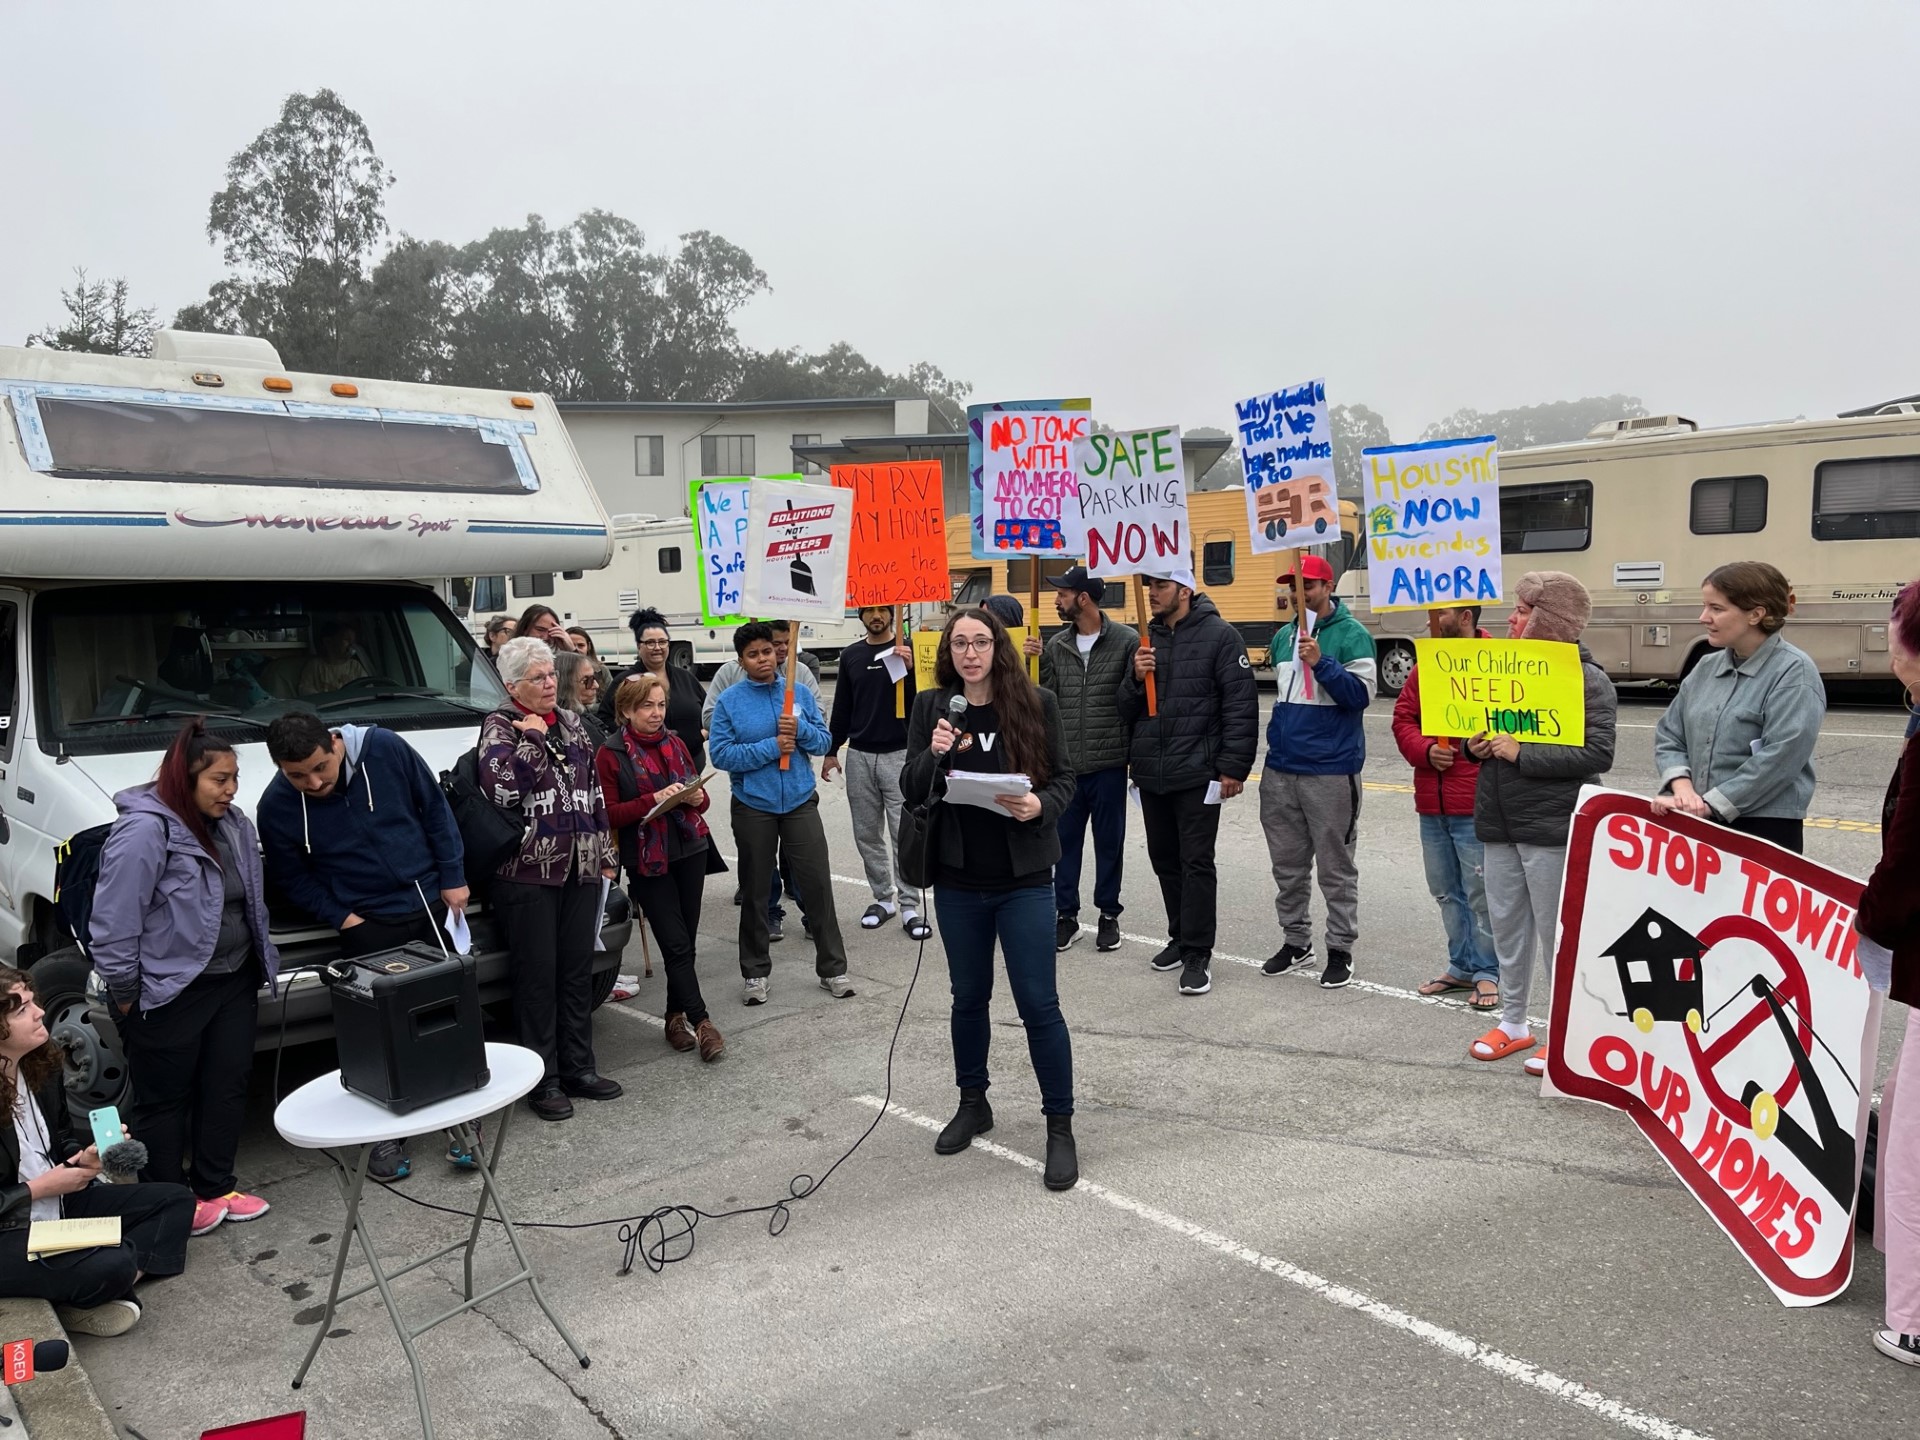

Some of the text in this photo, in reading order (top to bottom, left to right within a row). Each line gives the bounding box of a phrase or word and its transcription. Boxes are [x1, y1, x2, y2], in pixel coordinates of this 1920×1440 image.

[1235, 397, 1272, 427] Why
[1284, 410, 1316, 435] We
[991, 416, 1027, 452] NO
[1012, 445, 1068, 471] WITH
[1084, 429, 1176, 480] SAFE
[1242, 436, 1332, 475] have nowhere
[838, 467, 932, 504] MY RV
[996, 470, 1078, 498] NOWHER
[705, 491, 731, 514] We
[994, 497, 1062, 520] TO GO!
[1078, 480, 1182, 519] PARKING
[1403, 497, 1480, 529] NOW
[407, 513, 459, 537] Sport
[771, 507, 832, 524] SOLUTIONS
[889, 508, 941, 540] HOME
[709, 520, 722, 548] A
[777, 538, 822, 554] SWEEPS
[785, 527, 804, 536] NOT
[1087, 520, 1179, 569] NOW
[711, 552, 746, 576] Safe
[766, 554, 796, 563] HOUSING
[856, 546, 938, 577] have the
[715, 578, 739, 608] for
[848, 581, 888, 606] Right
[895, 578, 909, 602] 2
[912, 576, 946, 600] Stay
[1436, 650, 1549, 676] Our Children
[1451, 677, 1525, 704] NEED
[1446, 704, 1561, 737] Our HOMES
[1608, 814, 1721, 894] STOP
[1588, 1035, 1822, 1260] OUR HOMES
[13, 1343, 26, 1380] KQED
